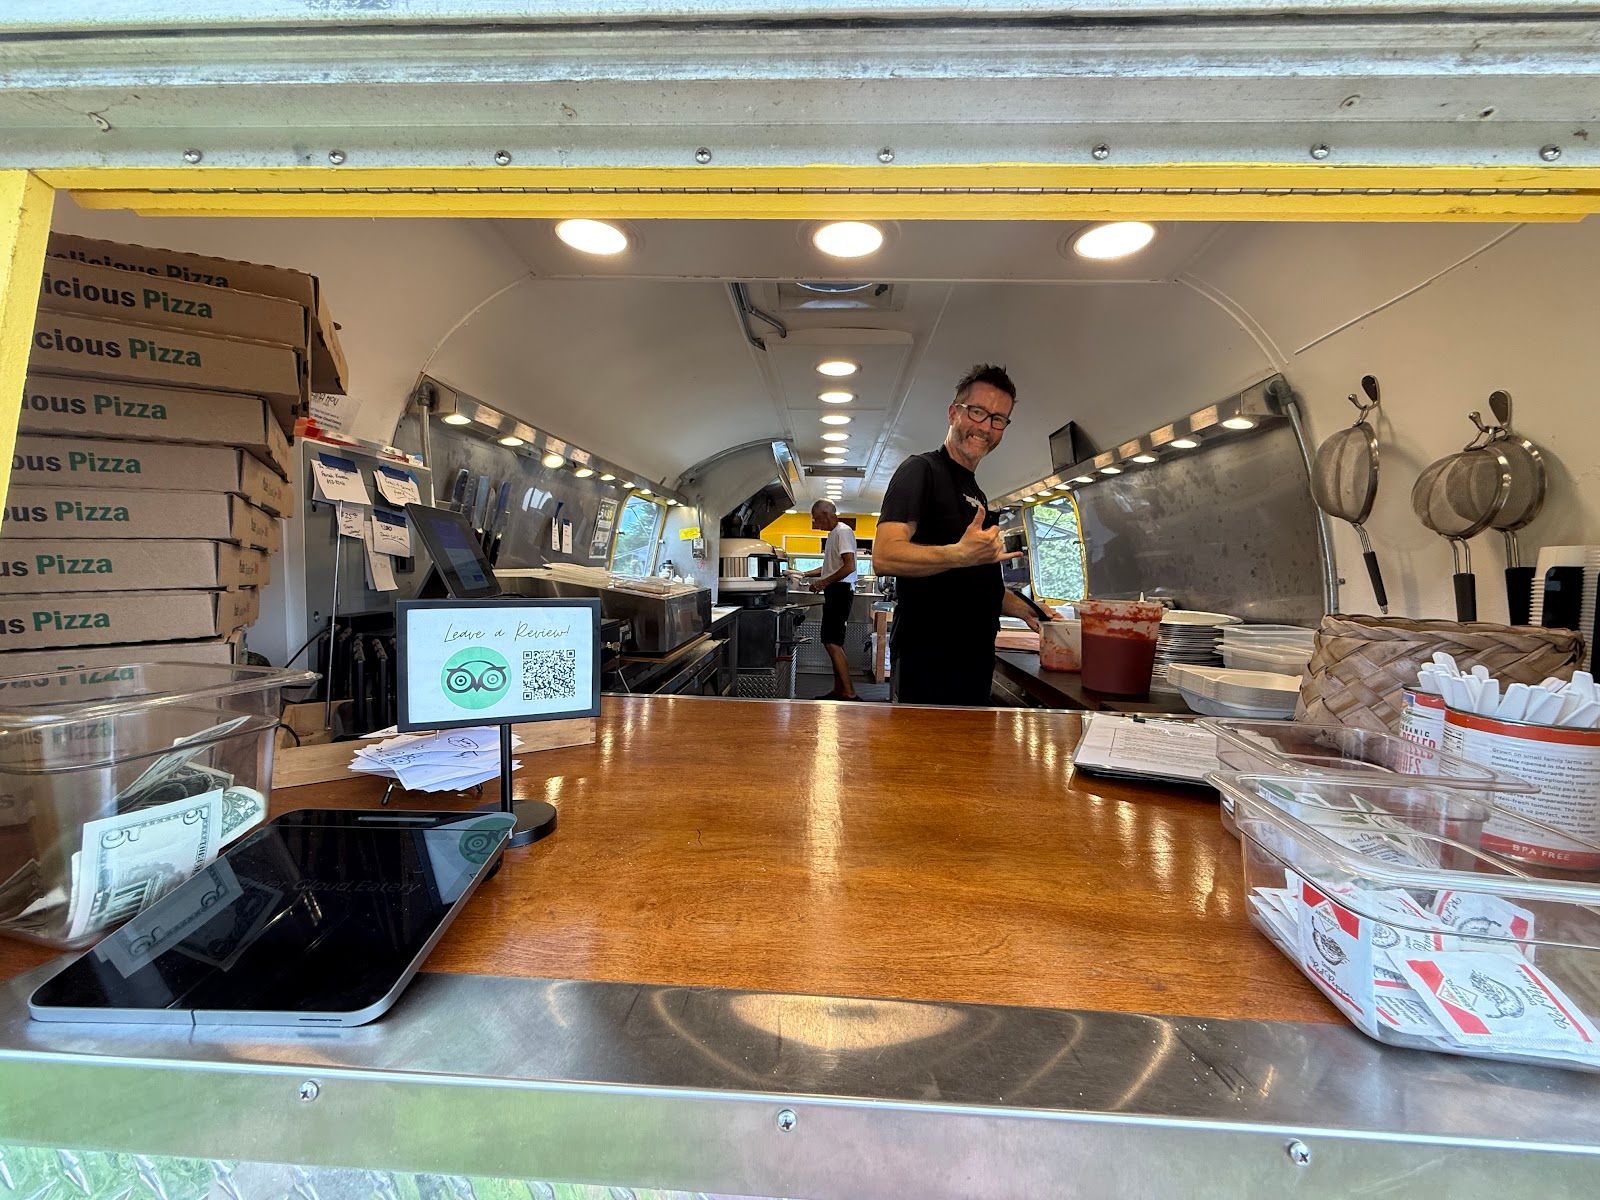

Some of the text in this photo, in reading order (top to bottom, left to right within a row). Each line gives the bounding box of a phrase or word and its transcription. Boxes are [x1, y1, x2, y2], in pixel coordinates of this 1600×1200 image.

[143, 288, 213, 319] Pizza
[35, 327, 202, 368] cious Pizza
[93, 394, 168, 420] Pizza
[68, 451, 142, 474] Pizza
[54, 501, 130, 522] Pizza
[36, 554, 113, 575] Pizza
[32, 611, 111, 632] Pizza
[443, 619, 571, 644] Leave a Review!
[1511, 843, 1571, 861] BPA FREE
